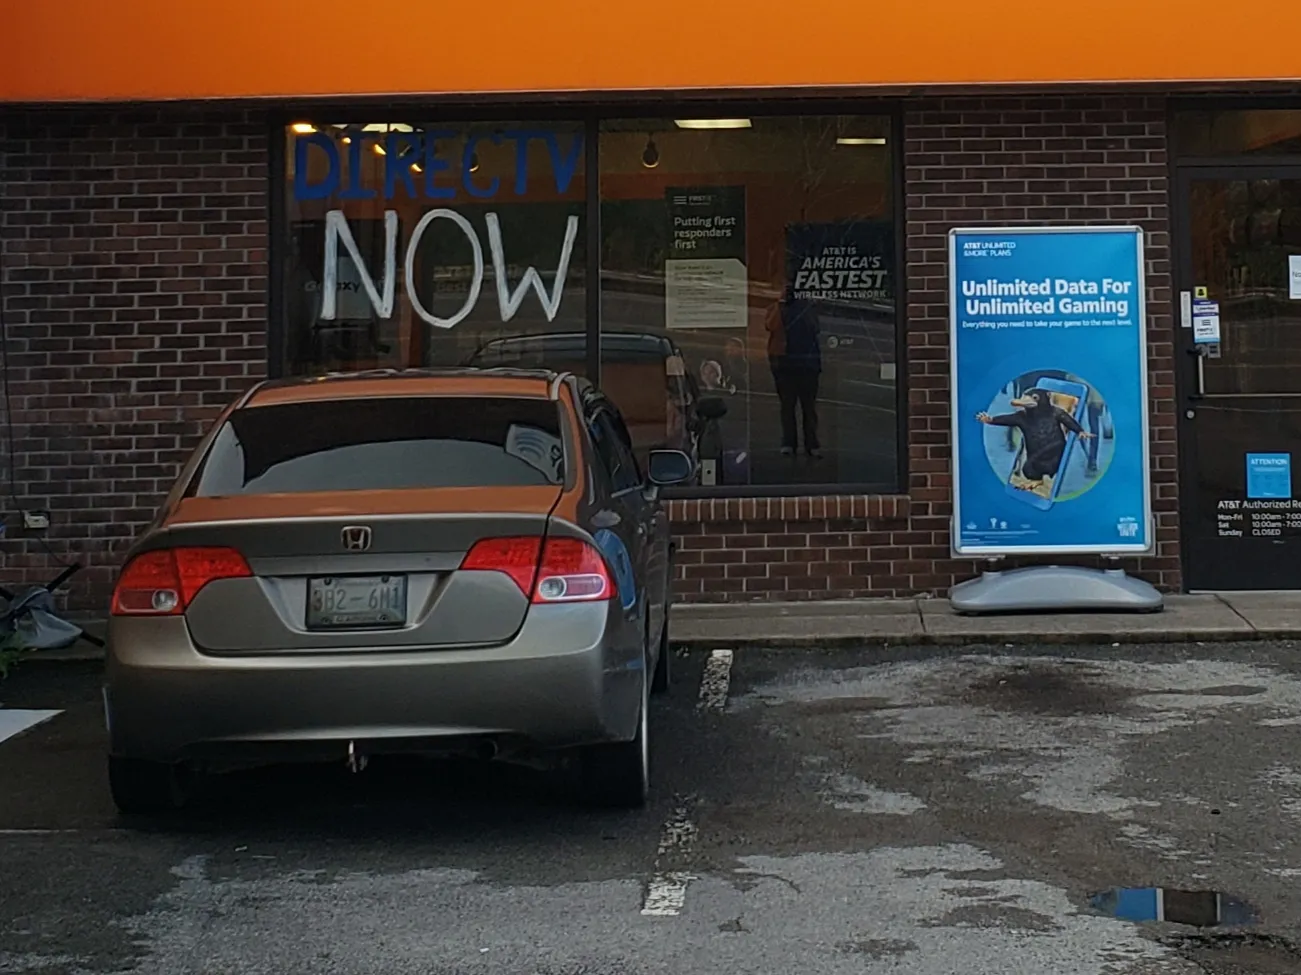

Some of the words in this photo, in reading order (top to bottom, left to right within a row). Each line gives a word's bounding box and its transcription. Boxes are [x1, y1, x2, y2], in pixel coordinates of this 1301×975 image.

[293, 129, 585, 201] DIRECTV
[673, 216, 712, 228] Putting
[713, 215, 737, 226] first
[673, 227, 733, 239] responders
[674, 238, 698, 249] first
[822, 246, 846, 256] AT&T
[847, 246, 857, 255] IS
[320, 208, 579, 328] NOW
[800, 255, 882, 270] AMERICA'S
[793, 269, 888, 290] FASTEST
[962, 278, 1051, 297] Unlimited
[1055, 278, 1098, 295] Data
[1102, 278, 1132, 295] For
[793, 290, 839, 300] WIRELESS
[839, 289, 887, 299] NETWORK
[966, 297, 1055, 315] Unlimited
[1058, 296, 1129, 317] Gaming
[1217, 500, 1241, 509] AT&T
[1242, 499, 1291, 509] Authorized
[1218, 529, 1243, 538] Sunday
[1252, 528, 1282, 536] CLOSED
